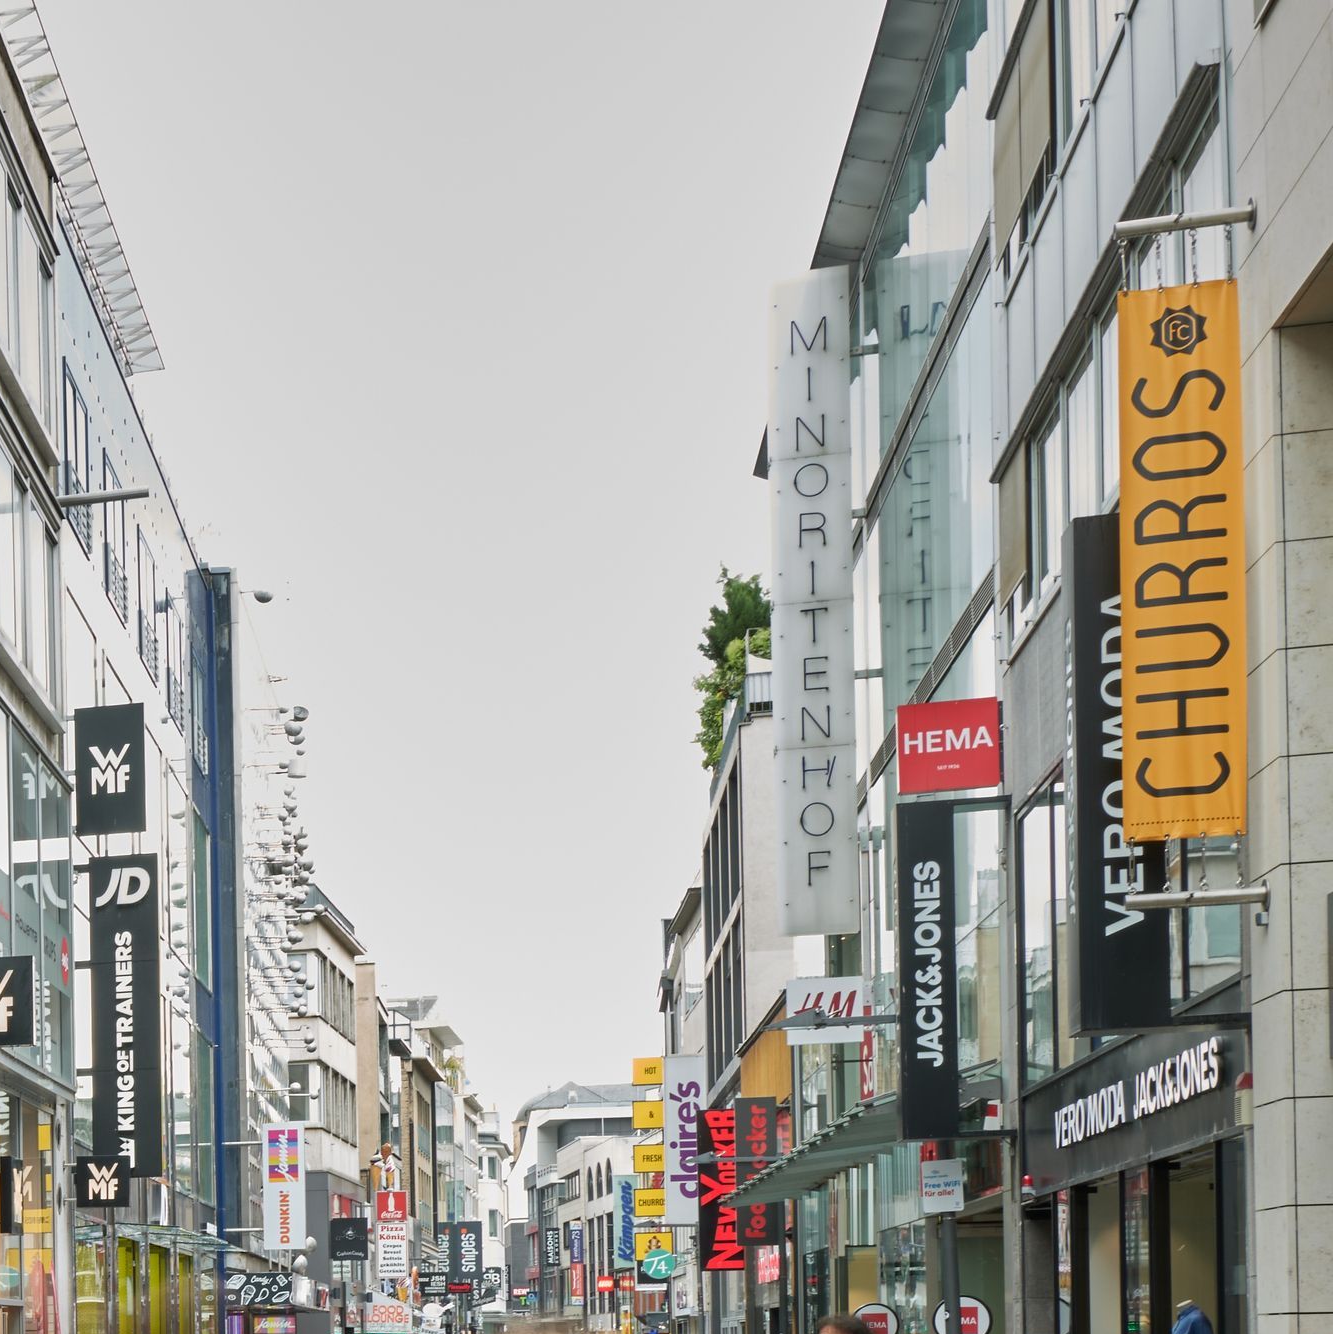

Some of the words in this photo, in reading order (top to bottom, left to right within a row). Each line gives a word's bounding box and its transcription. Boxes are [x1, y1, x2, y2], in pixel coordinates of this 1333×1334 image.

[790, 315, 836, 888] MINORITENHOF
[1132, 367, 1231, 800] CHURROS
[903, 725, 994, 755] HEMA
[89, 743, 130, 795] WMF
[95, 866, 151, 908] JD
[115, 930, 134, 1048] TRAINERS
[913, 860, 945, 1067] JACK&JONES
[117, 1049, 133, 1073] OF
[117, 1074, 134, 1131] KING
[1055, 1099, 1085, 1149] VERO
[1087, 1081, 1125, 1137] MODA
[1133, 1036, 1219, 1120] JACK&JONES
[642, 1154, 662, 1162] FRESH
[670, 1080, 701, 1199] claire's
[745, 1104, 767, 1179] ocker
[87, 1162, 119, 1200] WMF
[638, 1198, 665, 1207] CHURRO
[279, 1190, 290, 1244] DUNKIN'
[618, 1181, 633, 1262] Kämpgen
[461, 1233, 479, 1272] snipes
[251, 1275, 272, 1285] Candy!
[368, 1314, 409, 1323] LOUNGE
[373, 1305, 404, 1314] FOOD
